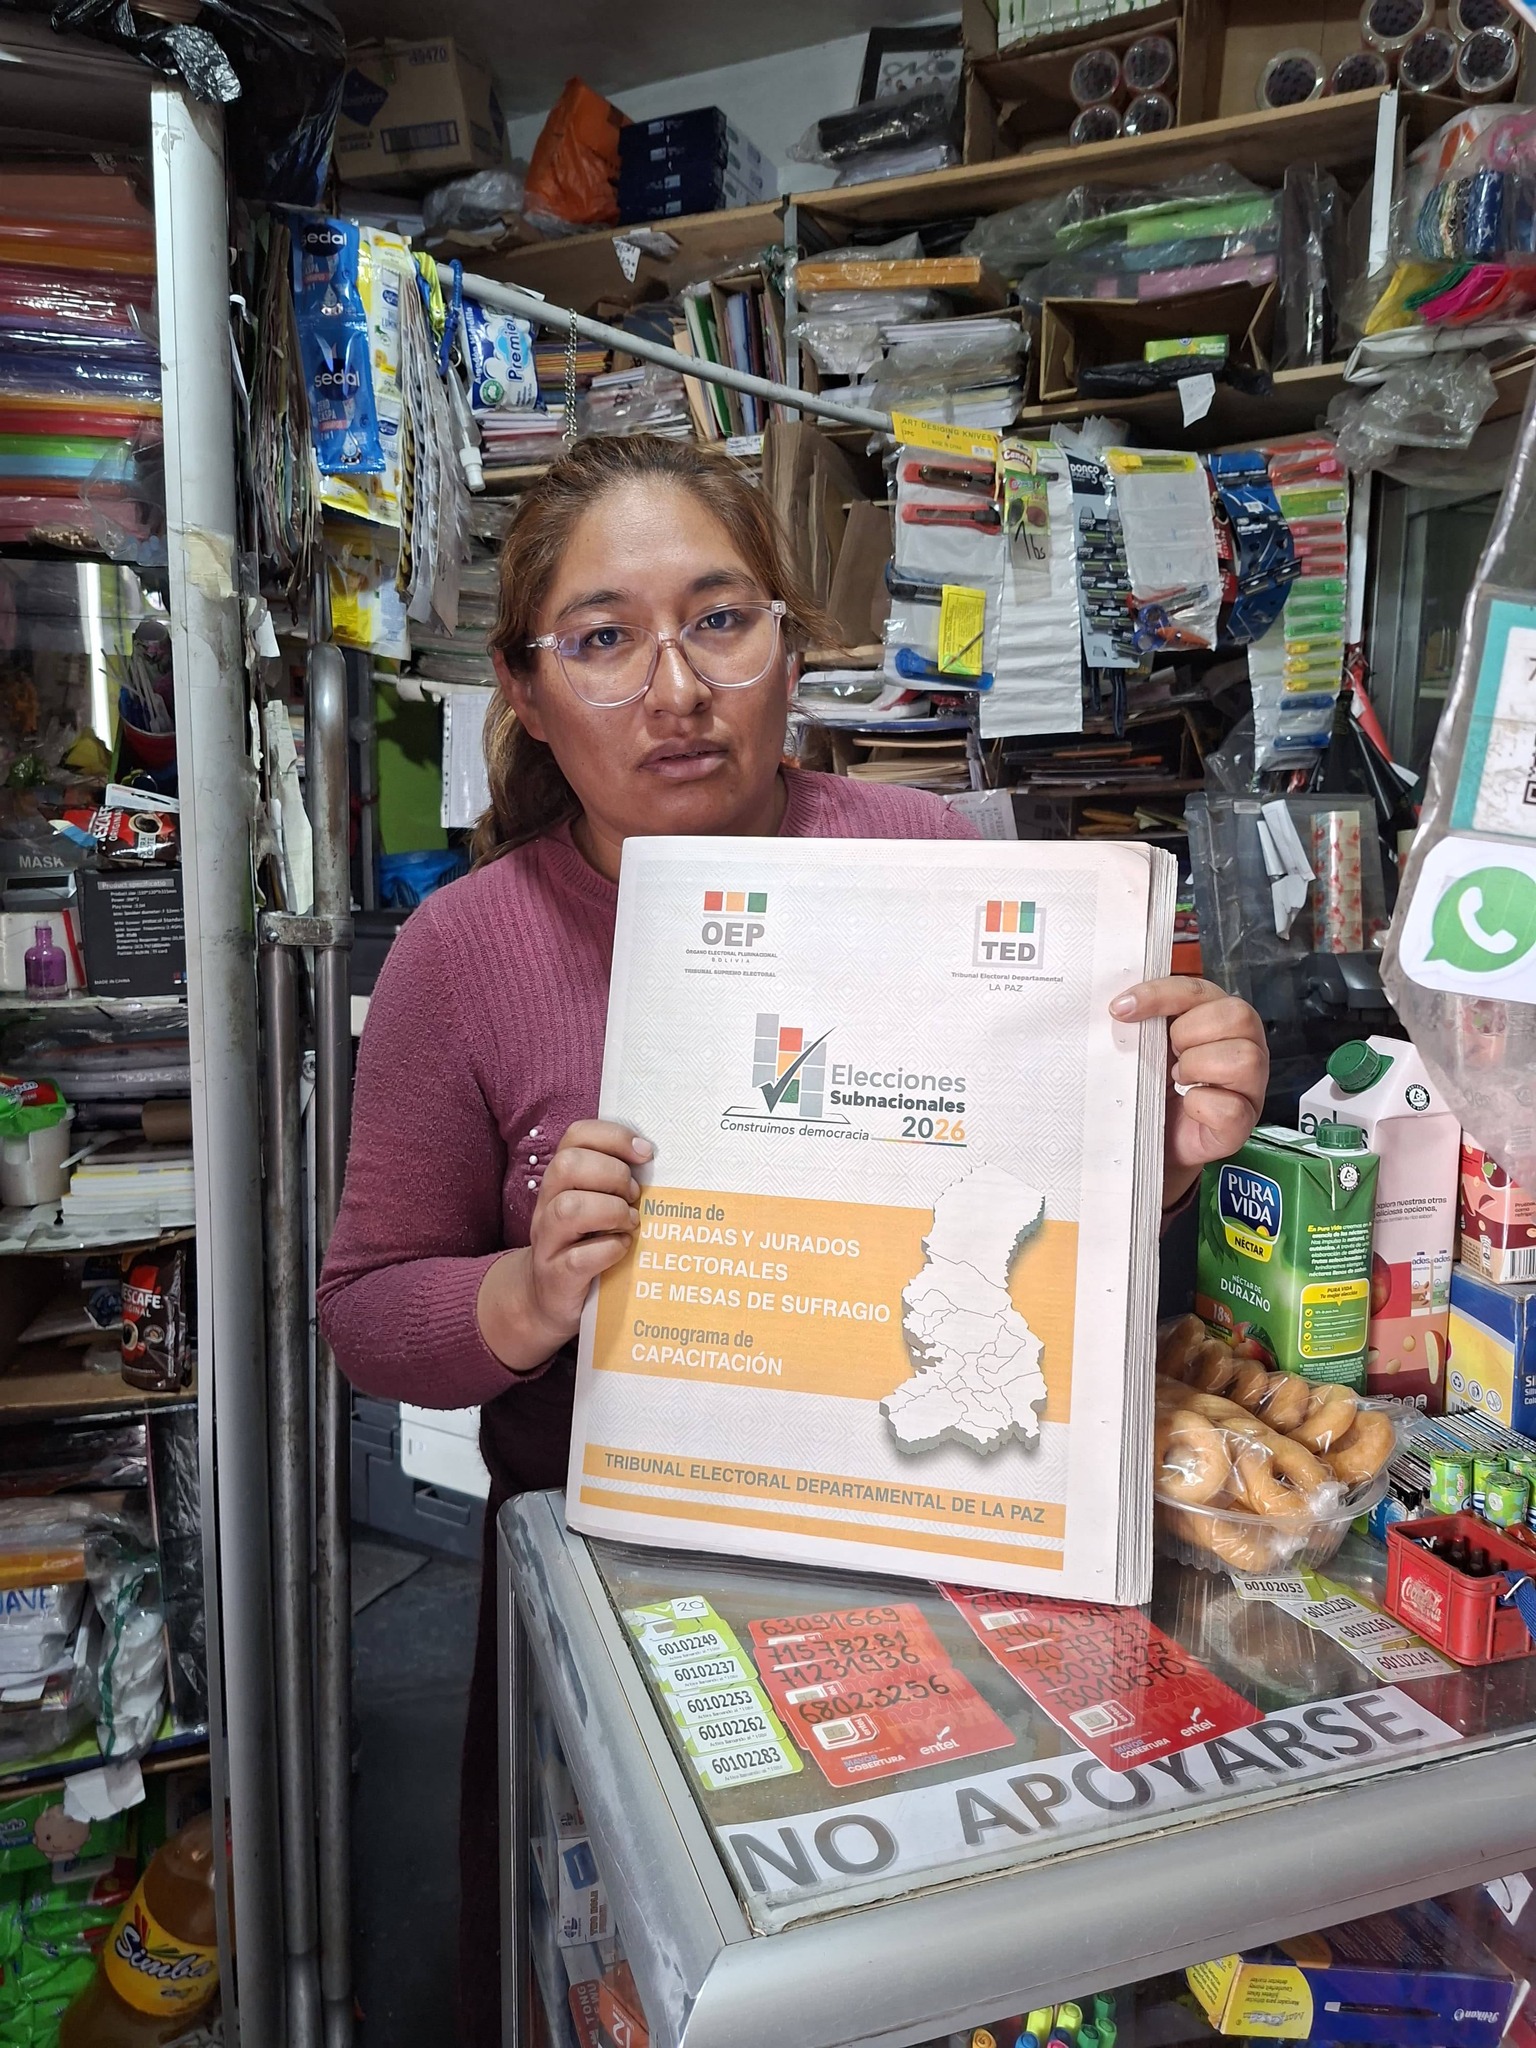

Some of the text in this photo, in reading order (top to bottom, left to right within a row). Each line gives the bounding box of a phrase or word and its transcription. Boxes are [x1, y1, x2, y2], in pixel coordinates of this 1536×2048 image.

[314, 368, 360, 387] sedal
[902, 418, 993, 442] ART DESIGING KNIVES
[19, 856, 64, 869] MASK
[701, 921, 765, 947] OEP
[981, 941, 1036, 962] TED
[989, 983, 1023, 992] LA PAZ
[1011, 974, 1063, 984] Departamental
[831, 1064, 966, 1093] Elecciones
[830, 1090, 966, 1114] Subnacionales
[720, 1119, 870, 1141] Construimos democracia
[902, 1116, 966, 1141] 2026
[1228, 1173, 1275, 1207] PURA
[644, 1199, 725, 1222] Nómina de
[1231, 1193, 1273, 1227] VIDA
[1376, 1201, 1396, 1209] xplora
[1397, 1198, 1426, 1206] nuestras
[640, 1222, 860, 1258] JURADAS Y JURADOS
[1235, 1236, 1264, 1257] NÉCTAR
[638, 1251, 789, 1282] ELECTORALES
[1221, 1278, 1271, 1313] DURAZNO
[1232, 1274, 1262, 1294] NÉCTAR DE
[123, 1287, 161, 1309] ESCAFE
[635, 1281, 891, 1323] DE MESAS DE SUFRAGIO
[1213, 1304, 1231, 1324] 18%
[633, 1319, 754, 1348] Cronograma de
[631, 1343, 783, 1376] CAPACITACIÓN
[604, 1452, 1046, 1524] TRIBUNAL ELECTORAL DEPARTAMENTAL DE LA PAZ
[1244, 1581, 1304, 1594] 60102053
[760, 1607, 900, 1636] 63091669
[1339, 1618, 1397, 1639] 60102161
[657, 1633, 718, 1656] 60102249
[759, 1630, 908, 1665] 71578281
[674, 1660, 735, 1682] 60102237
[770, 1647, 920, 1689] 71231936
[1376, 1651, 1439, 1671] 60102141
[1051, 1657, 1186, 1710] 73010670
[687, 1690, 752, 1713] 60102253
[799, 1674, 950, 1724] 68023256
[698, 1716, 766, 1741] 60102262
[1181, 1719, 1216, 1737] entel
[920, 1738, 960, 1756] entel
[1114, 1739, 1146, 1755] MAYOR
[1120, 1738, 1171, 1759] COBERTURA
[711, 1746, 781, 1775] 60102283
[844, 1754, 878, 1767] MAYOR
[847, 1754, 906, 1773] COBERTURA
[729, 1694, 1429, 1893] NO APOYARSE
[116, 1923, 214, 1980] Simba
[577, 1985, 595, 2024] TONG
[1465, 2010, 1499, 2023] Pelikan
